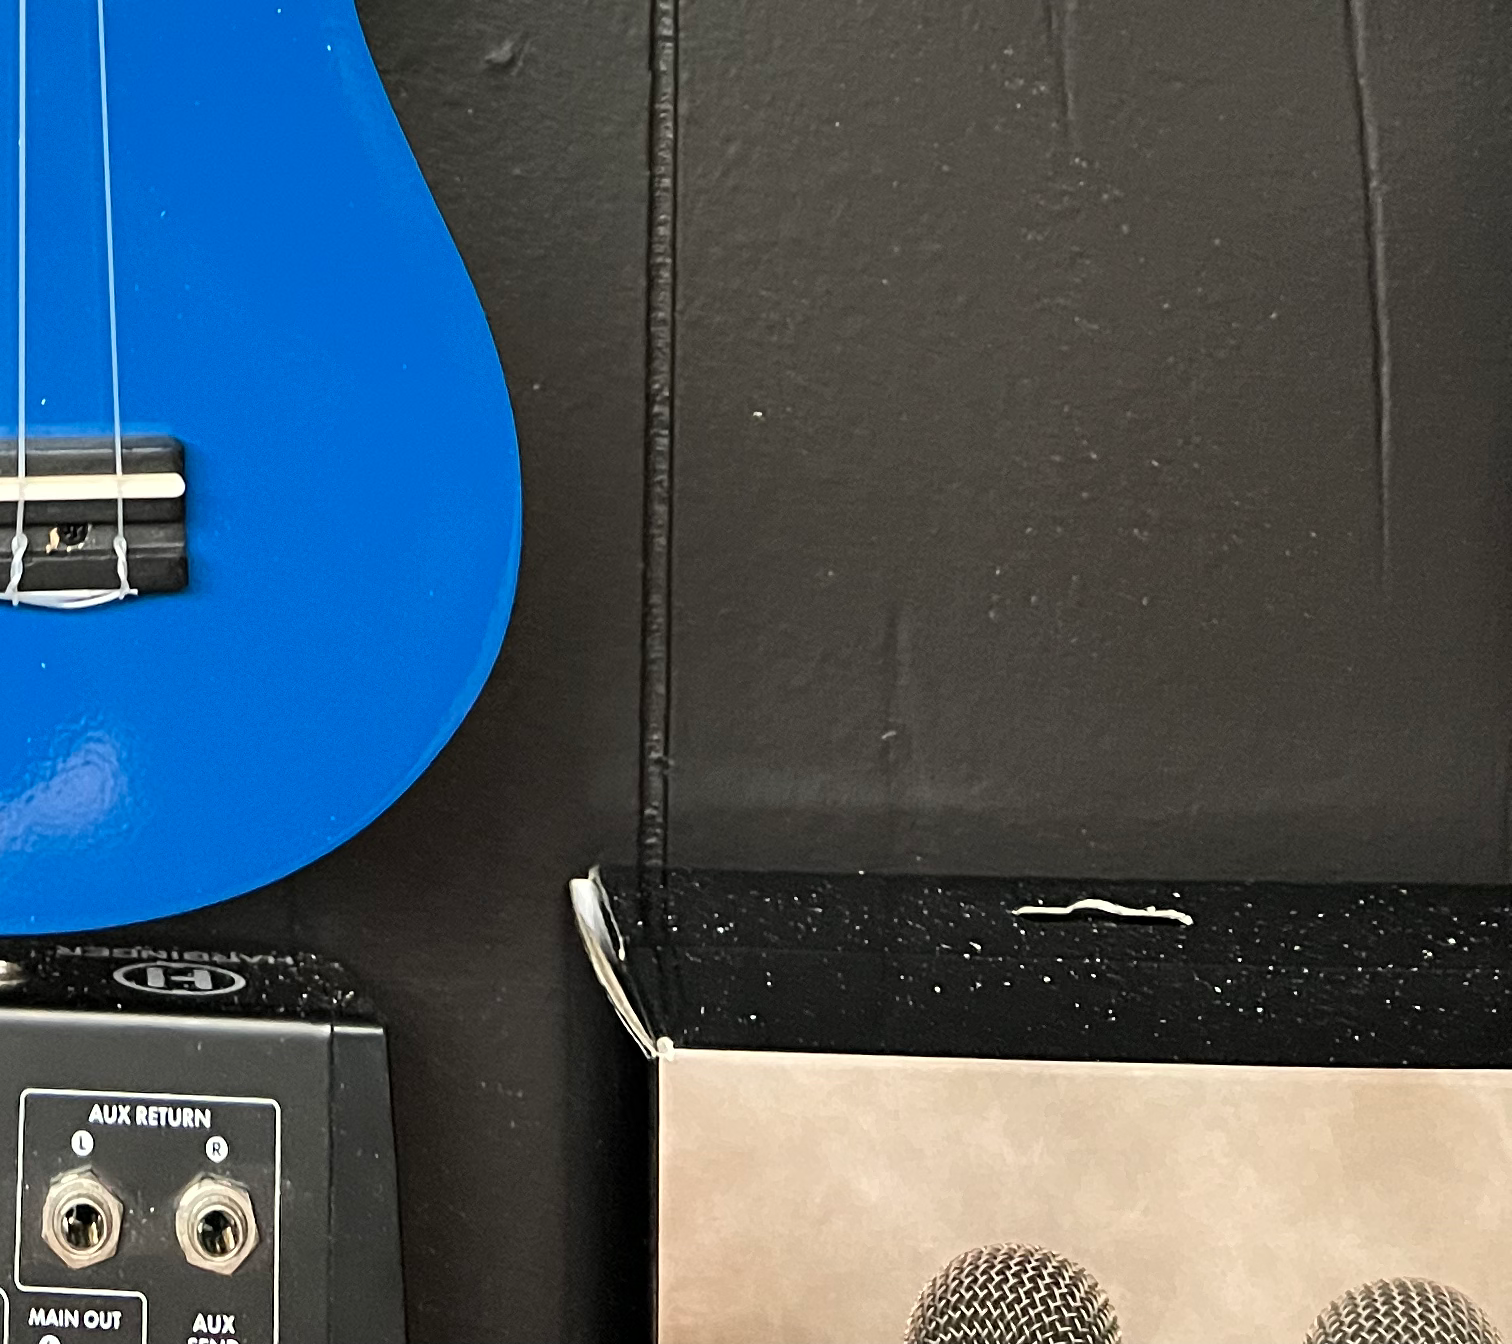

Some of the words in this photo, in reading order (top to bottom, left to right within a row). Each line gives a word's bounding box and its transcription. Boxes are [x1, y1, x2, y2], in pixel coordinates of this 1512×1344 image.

[88, 1103, 131, 1125] AUX
[135, 1107, 211, 1128] RETURN
[28, 1308, 79, 1328] MAIN
[83, 1311, 122, 1330] OUT
[192, 1312, 236, 1335] AUX
